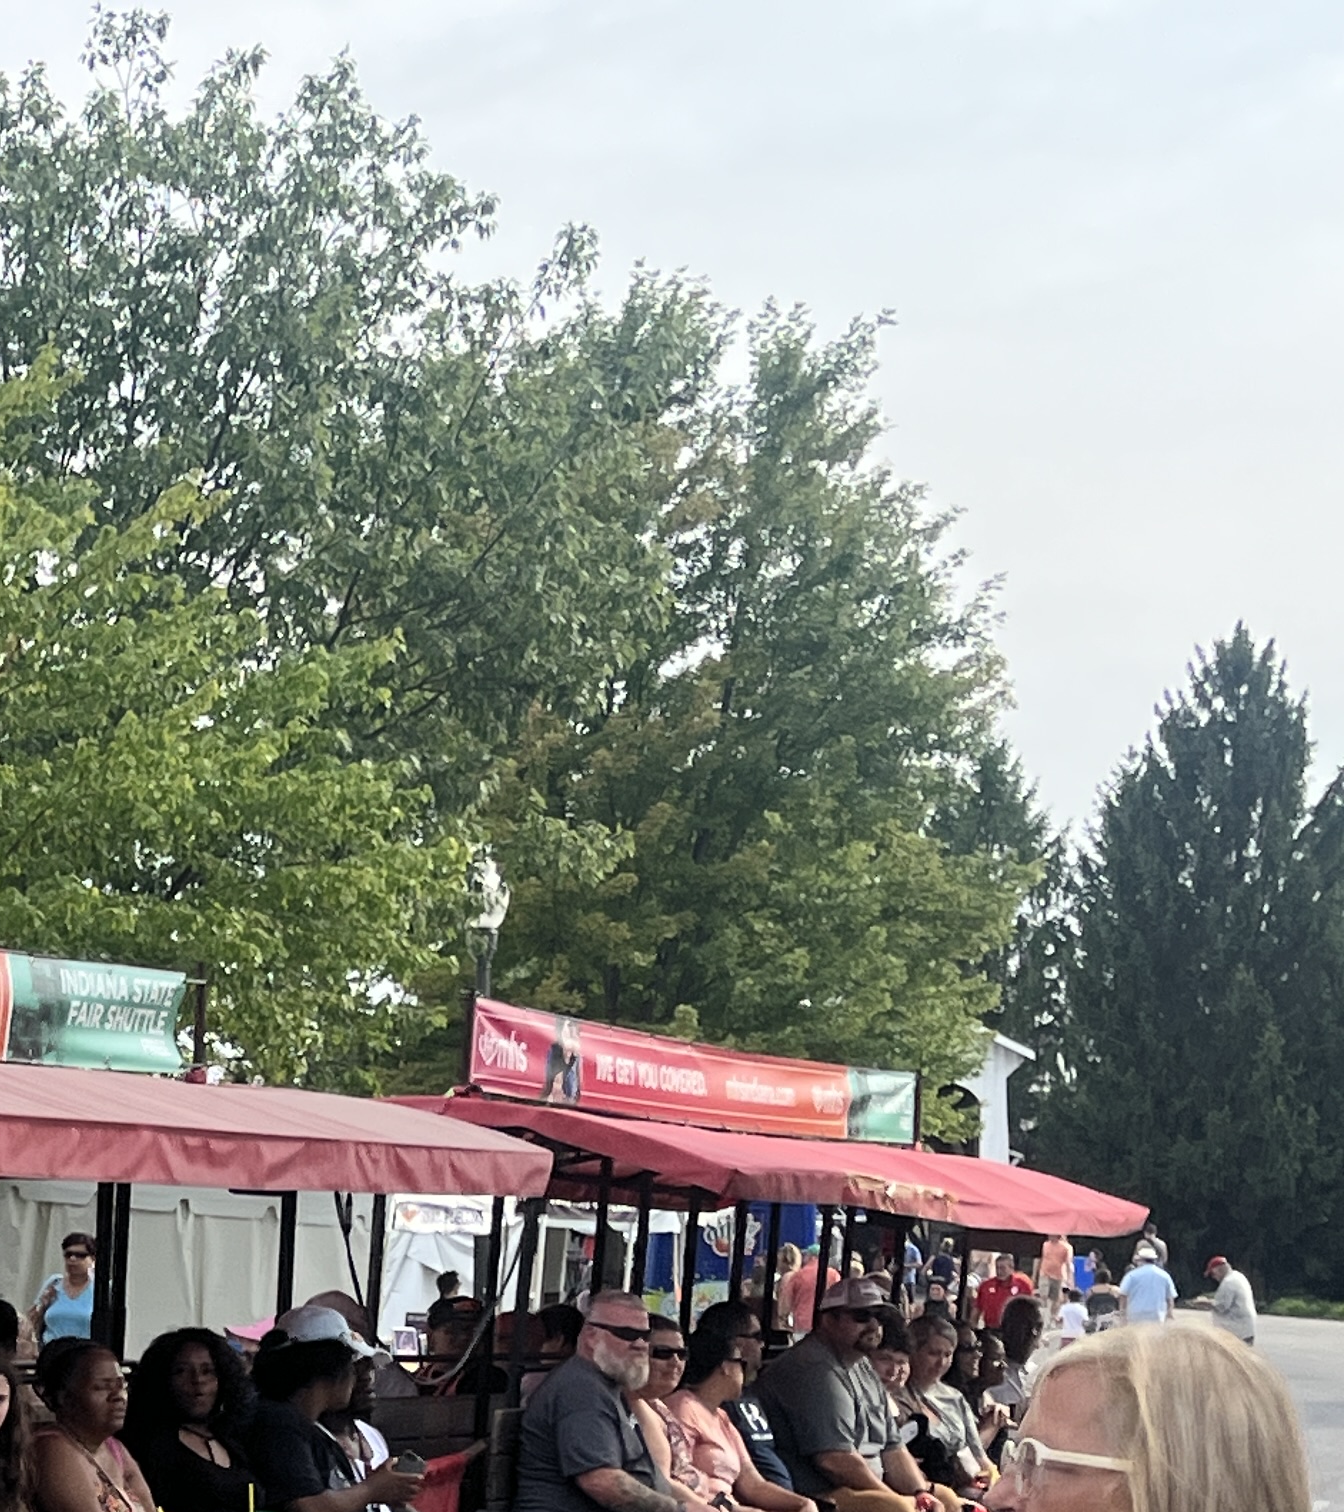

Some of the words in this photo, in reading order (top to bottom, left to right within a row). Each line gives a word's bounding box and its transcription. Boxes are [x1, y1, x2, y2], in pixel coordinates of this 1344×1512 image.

[59, 967, 129, 1003] INDIANA
[132, 978, 178, 1008] STATE
[67, 1000, 104, 1031] FAIR
[106, 1004, 169, 1036] SHUTTLE
